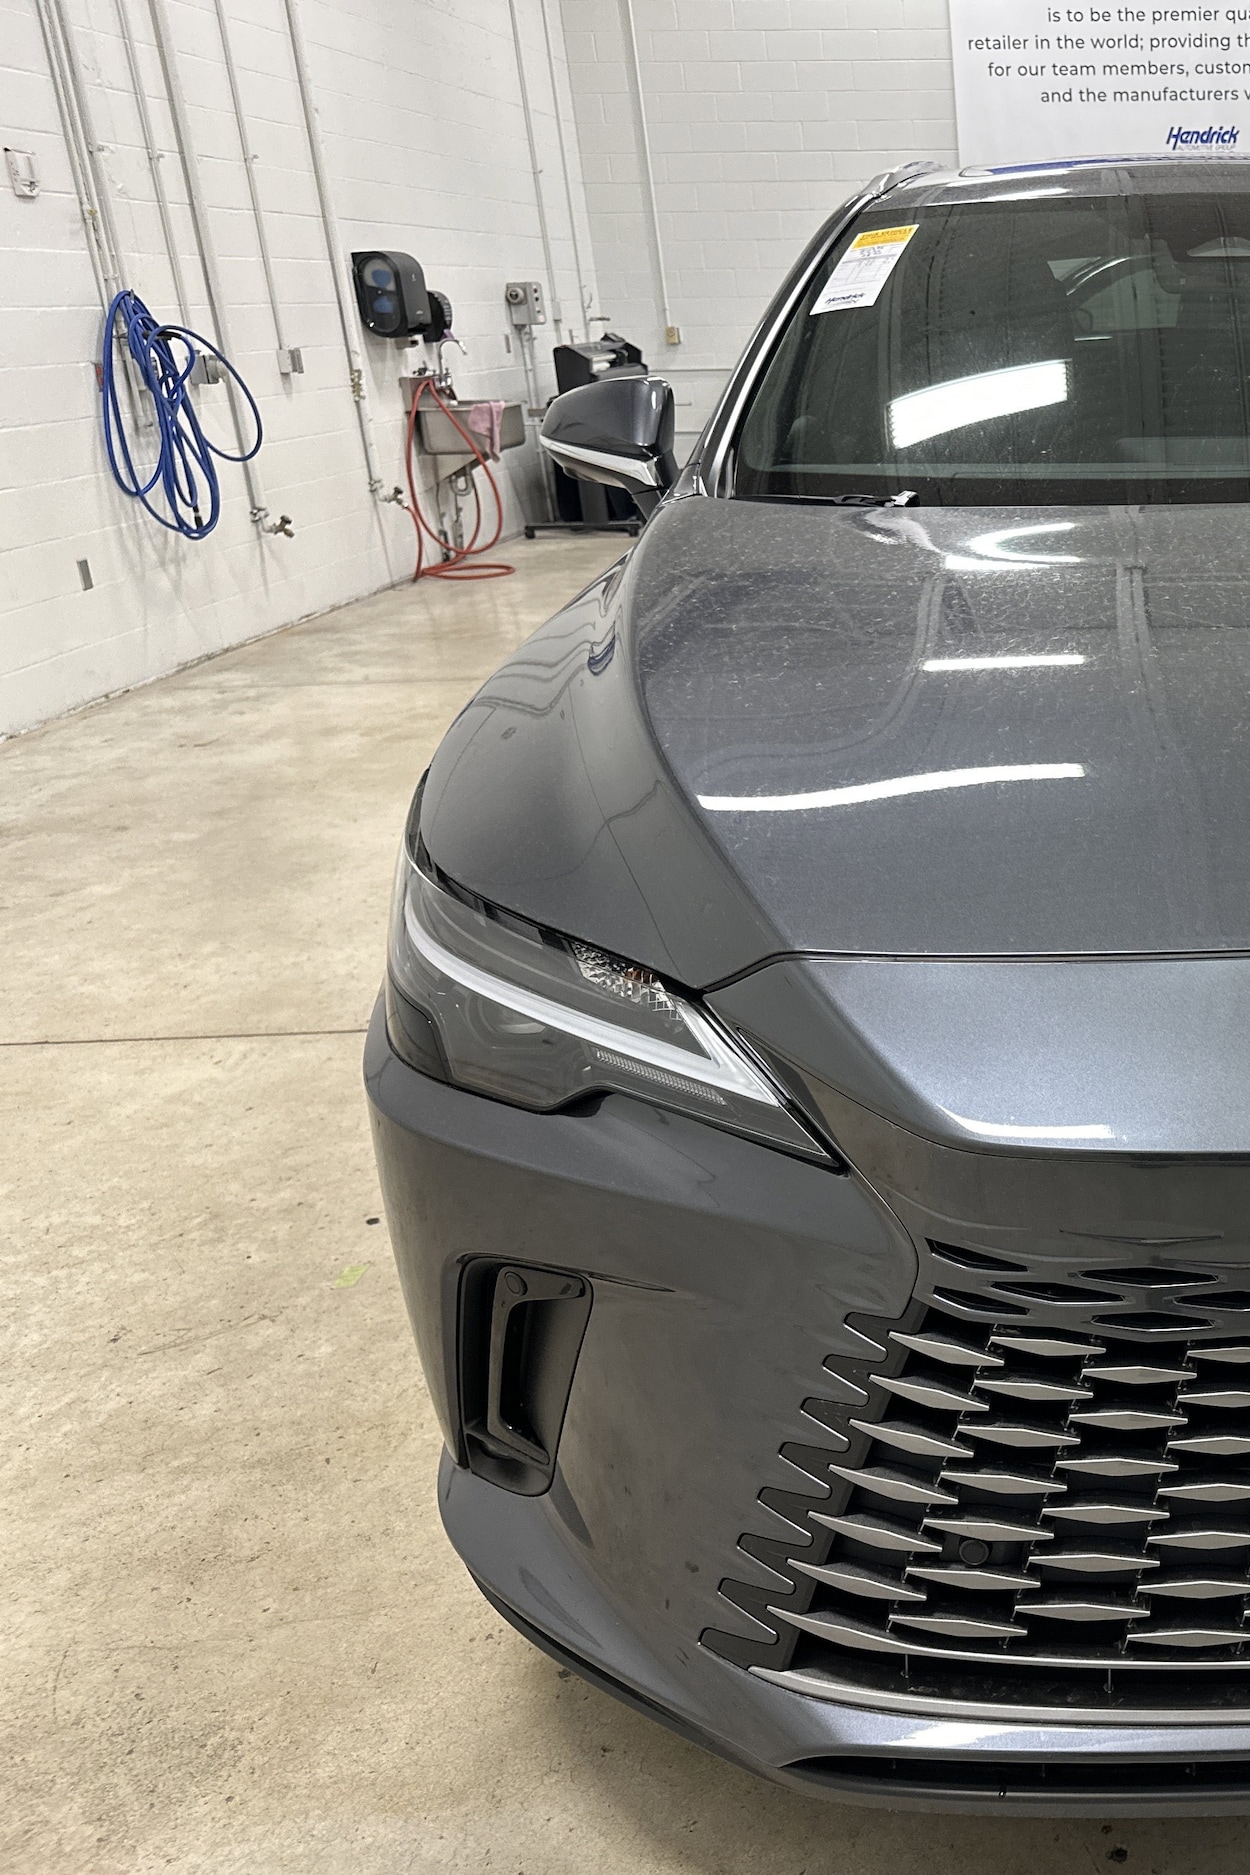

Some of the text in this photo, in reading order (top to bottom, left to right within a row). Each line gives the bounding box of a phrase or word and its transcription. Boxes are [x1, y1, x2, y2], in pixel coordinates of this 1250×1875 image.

[1047, 7, 1061, 23] is
[1066, 8, 1084, 23] to
[1089, 7, 1112, 23] be
[1117, 6, 1146, 23] the
[1152, 5, 1220, 25] premier
[967, 34, 1030, 50] retailer
[1034, 34, 1051, 50] in
[1056, 33, 1086, 50] the
[1090, 33, 1144, 51] world;
[1149, 32, 1231, 52] providing
[987, 61, 1012, 77] for
[1017, 64, 1047, 77] our
[1052, 62, 1097, 77] team
[1102, 60, 1190, 77] members,
[1040, 87, 1073, 103] and
[1078, 87, 1108, 102] the
[1112, 86, 1240, 102] manufacturers
[1165, 126, 1240, 150] Hendrick
